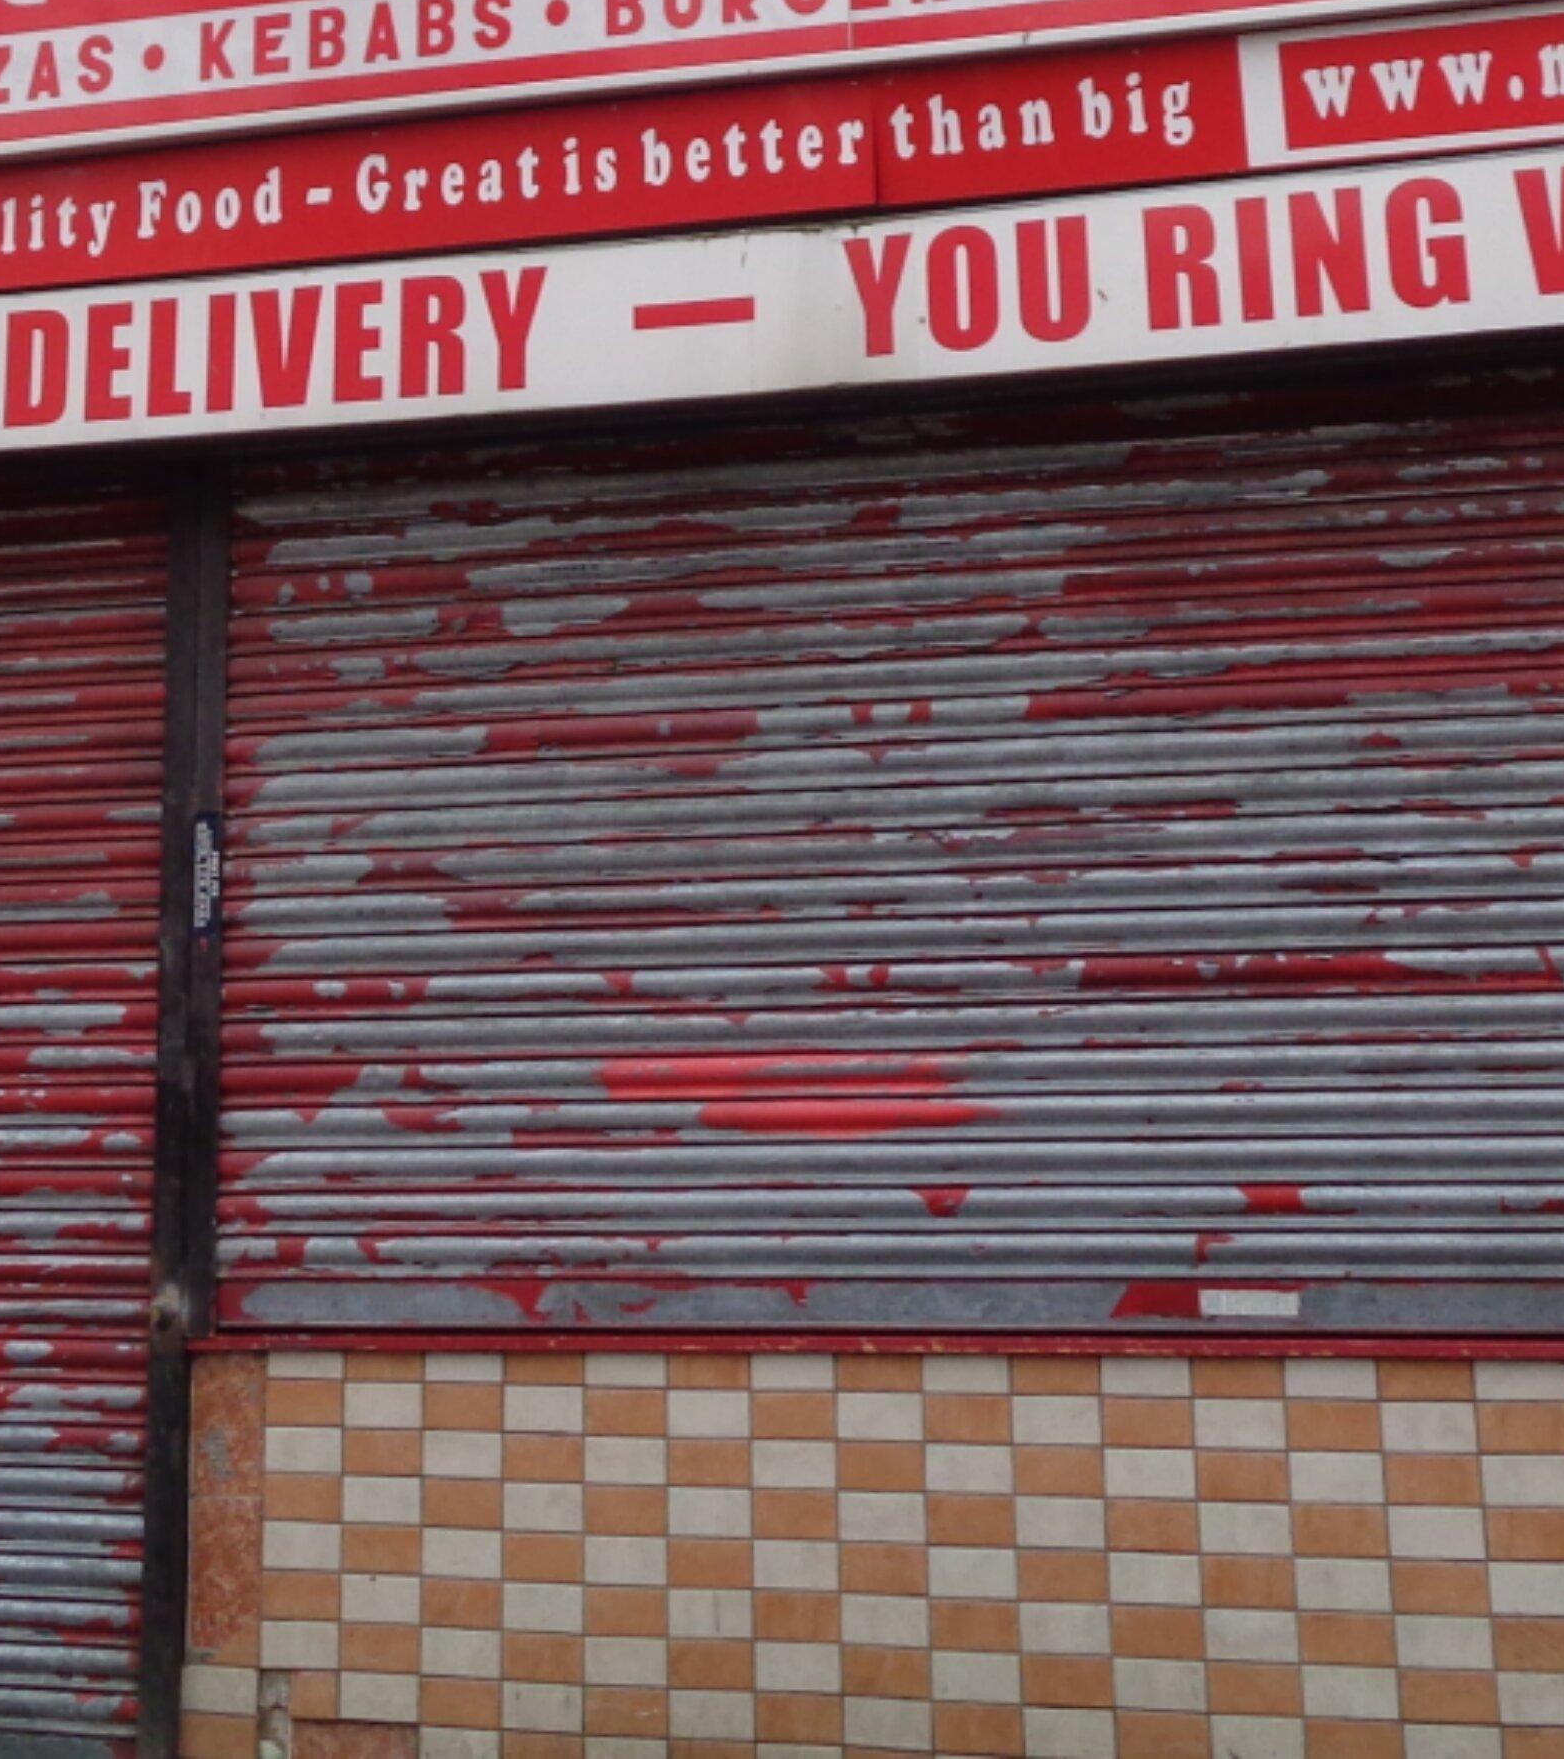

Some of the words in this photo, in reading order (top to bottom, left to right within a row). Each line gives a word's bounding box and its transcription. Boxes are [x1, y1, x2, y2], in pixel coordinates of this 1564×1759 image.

[137, 166, 285, 242] Food
[355, 135, 541, 215] Great
[563, 125, 619, 195] is
[642, 112, 865, 188] better
[891, 90, 1056, 161] than
[1078, 67, 1196, 146] big
[2, 265, 549, 428] DELIVERY
[842, 214, 1092, 357] YOU
[1141, 176, 1472, 332] RING
